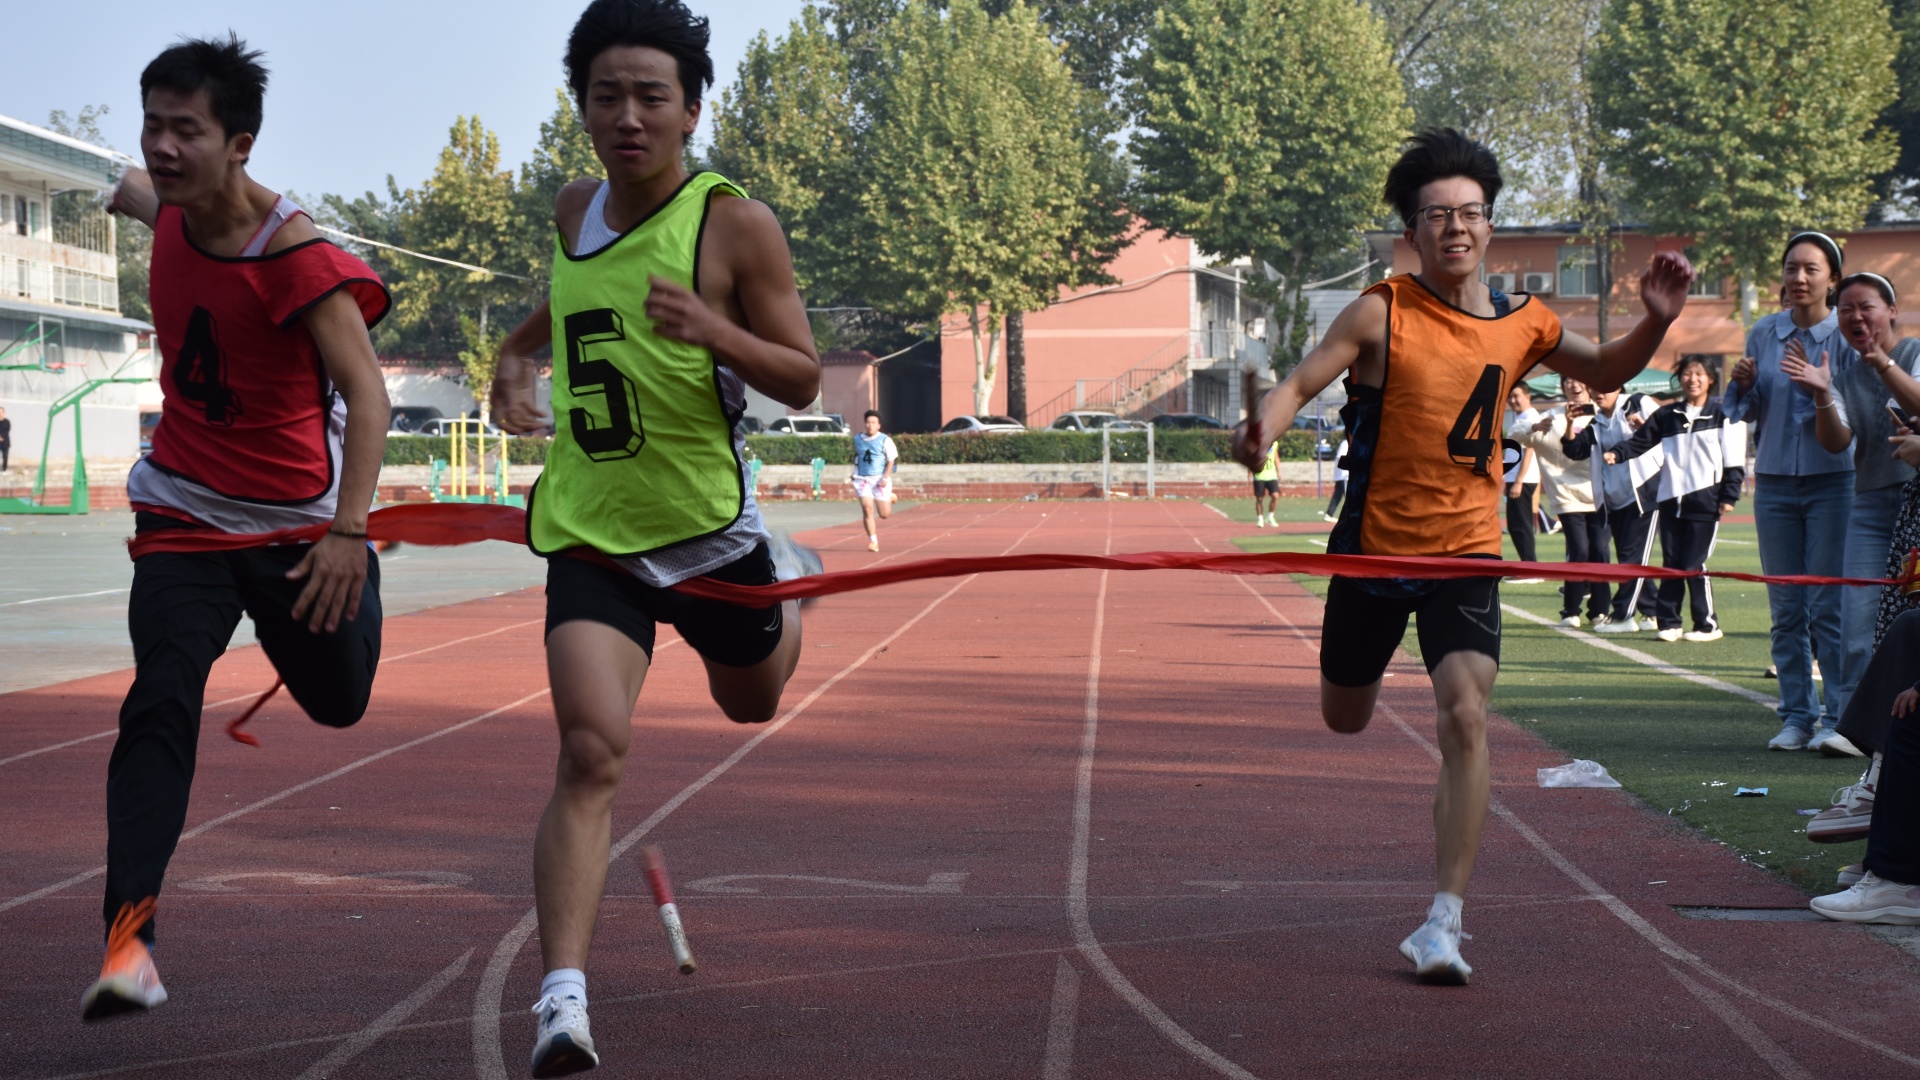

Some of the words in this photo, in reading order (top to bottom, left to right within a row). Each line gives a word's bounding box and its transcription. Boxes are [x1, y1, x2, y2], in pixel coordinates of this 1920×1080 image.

[172, 304, 243, 427] 4
[564, 308, 646, 463] 5
[1446, 364, 1506, 477] 4
[863, 449, 872, 464] 4
